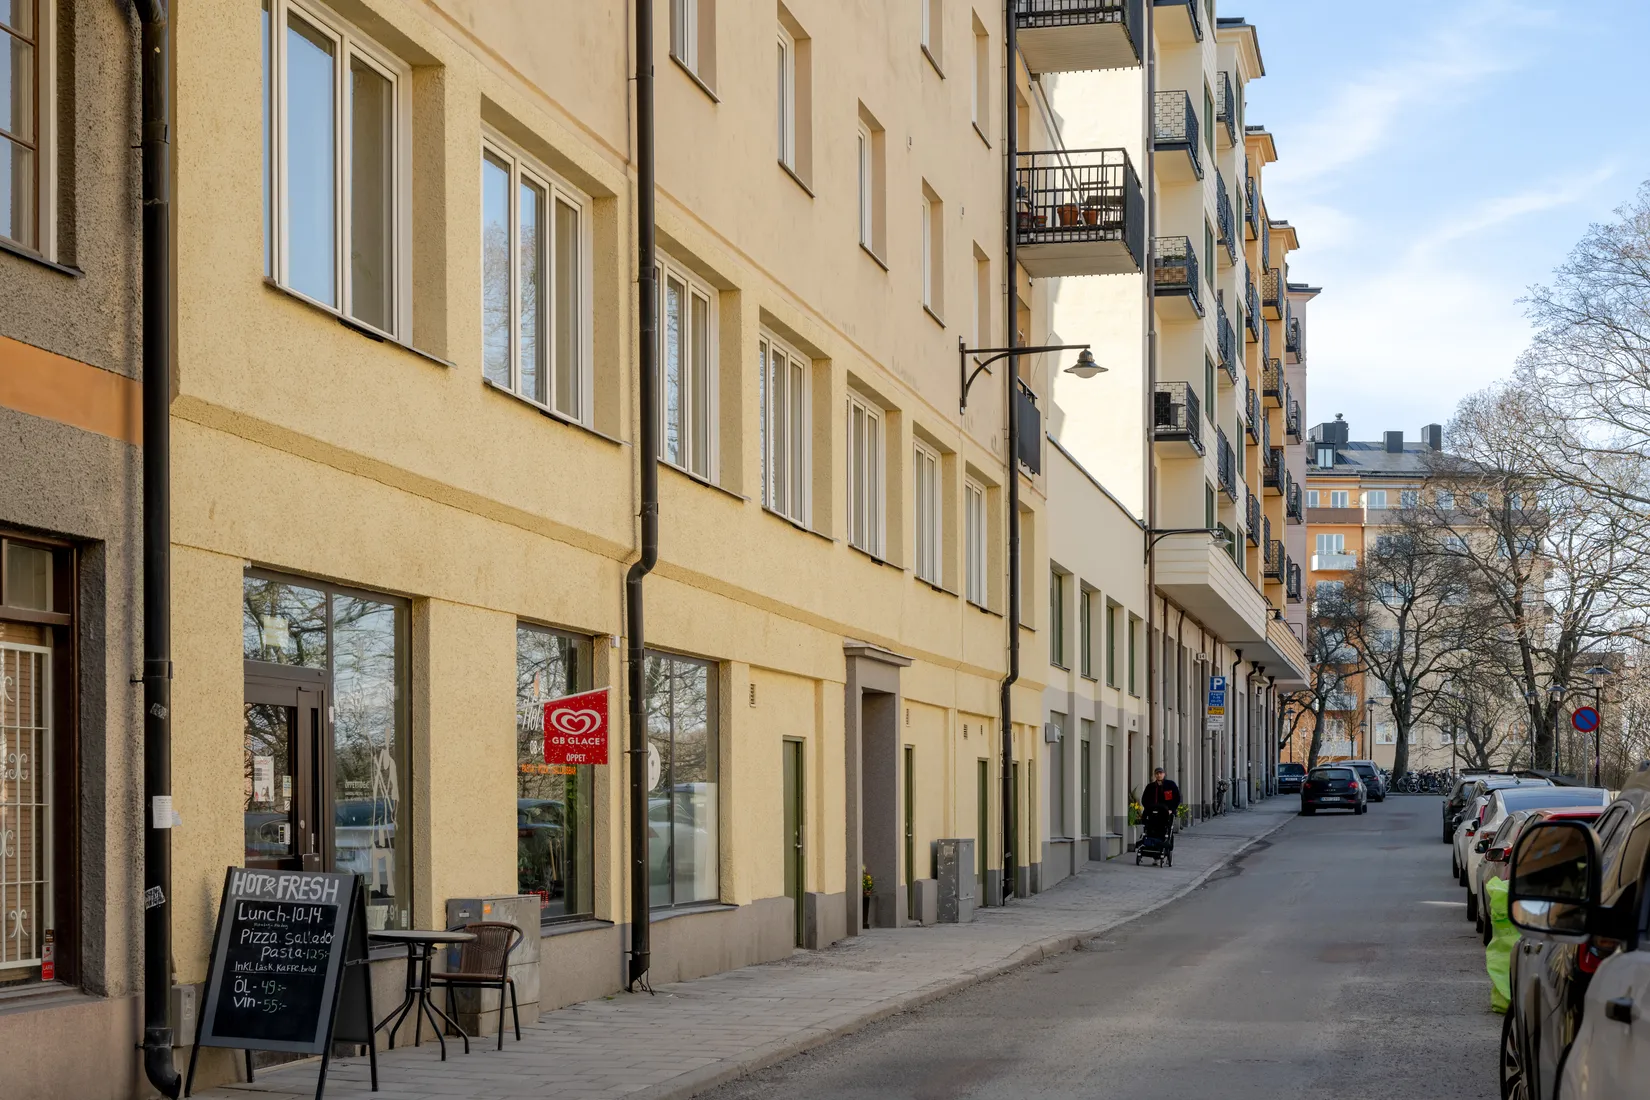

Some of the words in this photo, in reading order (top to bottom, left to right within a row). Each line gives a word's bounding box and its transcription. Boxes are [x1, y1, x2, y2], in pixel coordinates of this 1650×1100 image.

[1213, 677, 1223, 690] P
[551, 736, 565, 745] GB
[567, 737, 600, 746] GLACE
[566, 752, 586, 762] ÖPPET
